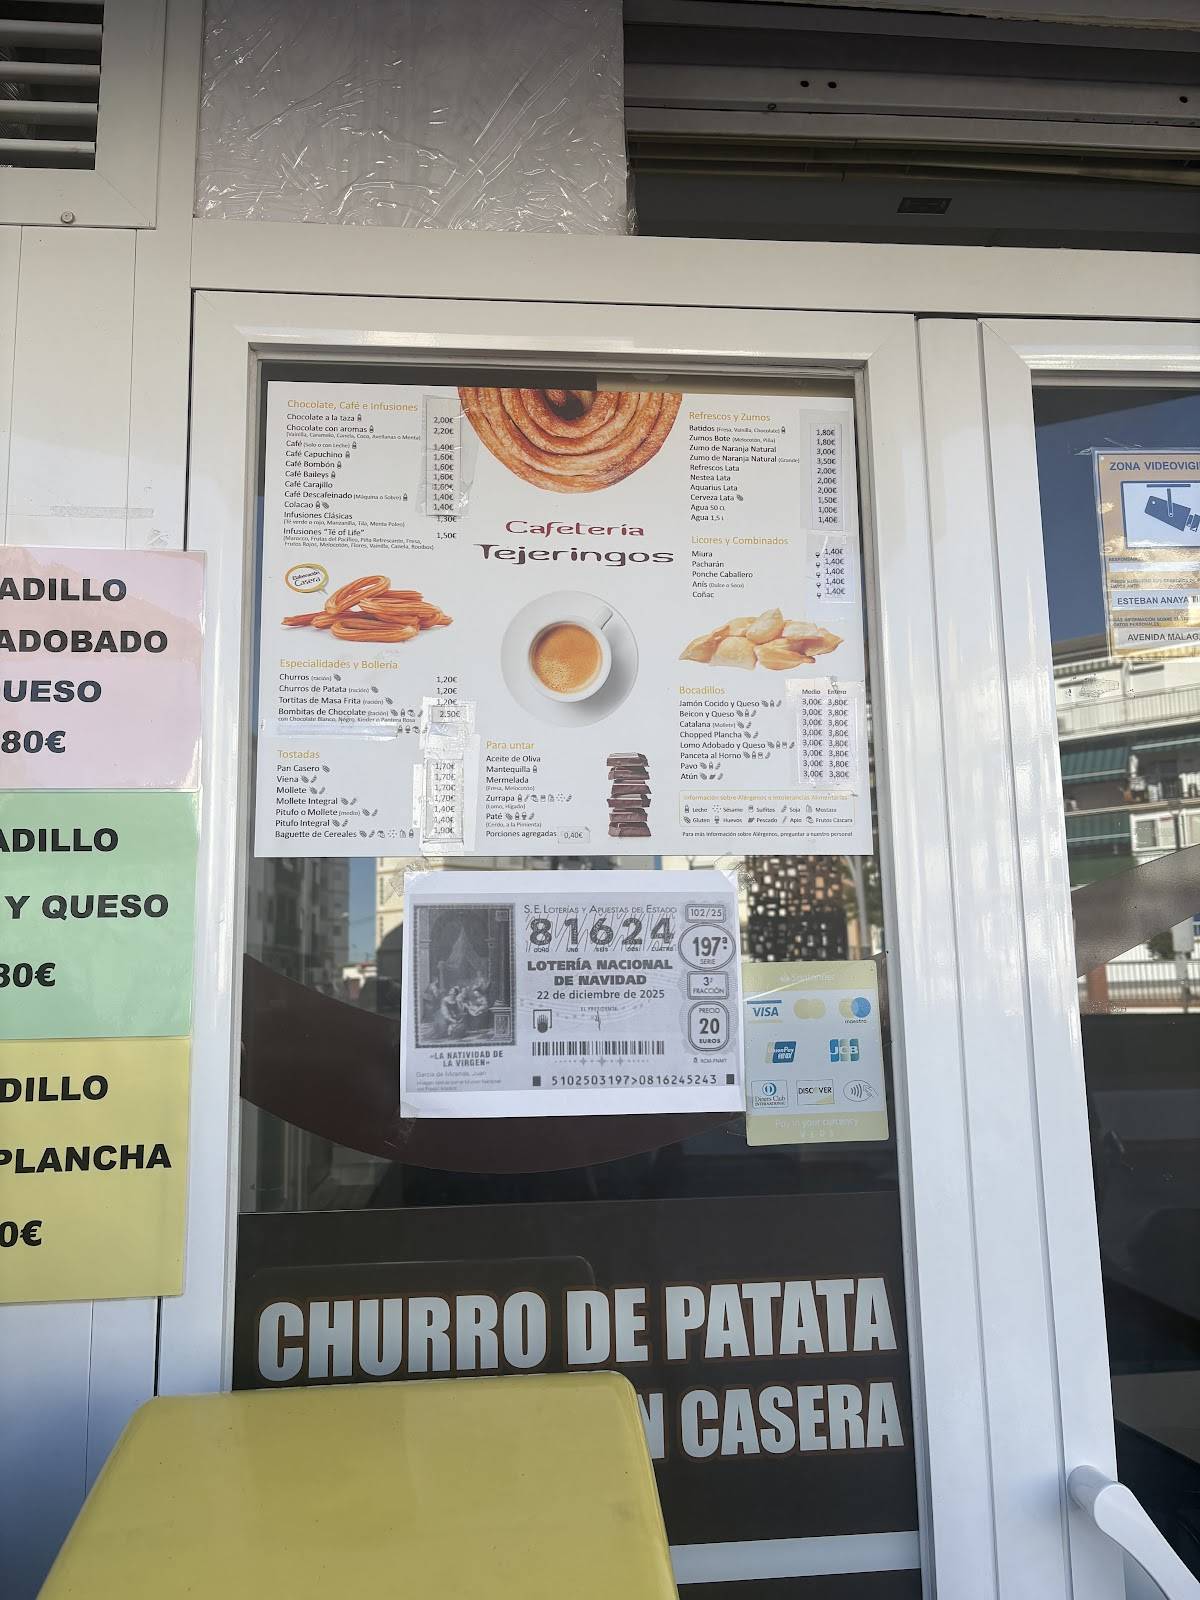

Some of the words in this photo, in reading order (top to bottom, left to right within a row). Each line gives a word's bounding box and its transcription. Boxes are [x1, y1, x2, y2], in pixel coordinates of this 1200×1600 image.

[287, 400, 336, 410] Chocolate,
[339, 401, 360, 411] Café
[370, 402, 418, 411] Infusiones
[689, 412, 731, 422] Refrescos
[740, 413, 771, 422] Zumos
[286, 424, 323, 433] Chocolate
[324, 426, 338, 434] con
[304, 450, 343, 458] Capuchino
[722, 445, 749, 453] Naranja
[1109, 461, 1141, 471] ZONA
[1144, 461, 1200, 471] VIDEOVIGI
[303, 471, 329, 479] Baileys
[284, 480, 301, 488] Café
[303, 481, 333, 489] Carajillo
[284, 511, 322, 520] Infusiones
[323, 512, 353, 520] Clásicas
[505, 521, 644, 538] Cafetería
[692, 536, 723, 544] Licores
[731, 536, 789, 545] Combinados
[473, 543, 675, 567] Tejeringos
[0, 577, 127, 602] ADILLO
[1117, 596, 1159, 605] ESTEBAN
[1160, 595, 1190, 604] ANAYA
[0, 629, 168, 653] ADOBADO
[1127, 633, 1166, 641] AVENIDA
[1168, 632, 1200, 641] MALAG
[280, 659, 351, 671] Especialidades
[360, 660, 399, 671] Bollería
[3, 680, 102, 703] UESO
[679, 686, 725, 695] Bocadillos
[279, 696, 308, 704] Tortitas
[328, 708, 366, 716] Chocolate
[679, 720, 711, 728] Catalana
[680, 731, 712, 740] Chopped
[486, 740, 507, 749] Para
[509, 740, 535, 751] untar
[277, 750, 320, 759] Tostadas
[277, 764, 291, 772] Pan
[276, 786, 307, 794] Mollete
[308, 797, 338, 806] Integral
[486, 795, 515, 803] Zurrapa
[486, 812, 503, 820] Paté
[275, 819, 299, 827] Pitufo
[300, 819, 330, 828] Integral
[275, 831, 310, 839] Baguette
[324, 830, 357, 838] Cereales
[4, 896, 31, 920] Y
[42, 894, 169, 921] QUESO
[690, 907, 722, 917] 102/25
[527, 957, 592, 971] LOTERÍA
[596, 959, 673, 970] NACIONAL
[554, 975, 574, 986] DE
[578, 975, 647, 986] NAVIDAD
[537, 990, 549, 1000] 22
[552, 990, 566, 1000] de
[569, 989, 620, 999] diciembre
[623, 989, 637, 999] de
[640, 989, 665, 999] 2025
[693, 986, 725, 995] FRACCIÓN
[752, 1006, 779, 1017] VISA
[699, 1018, 720, 1035] 20
[447, 1050, 490, 1060] NATIVIDAD
[552, 1074, 717, 1086] 5102503197>0816245243
[257, 1291, 548, 1382] CHURRO
[566, 1287, 649, 1365] DE
[665, 1276, 898, 1361] PATATA
[681, 1381, 904, 1459] CASERA
